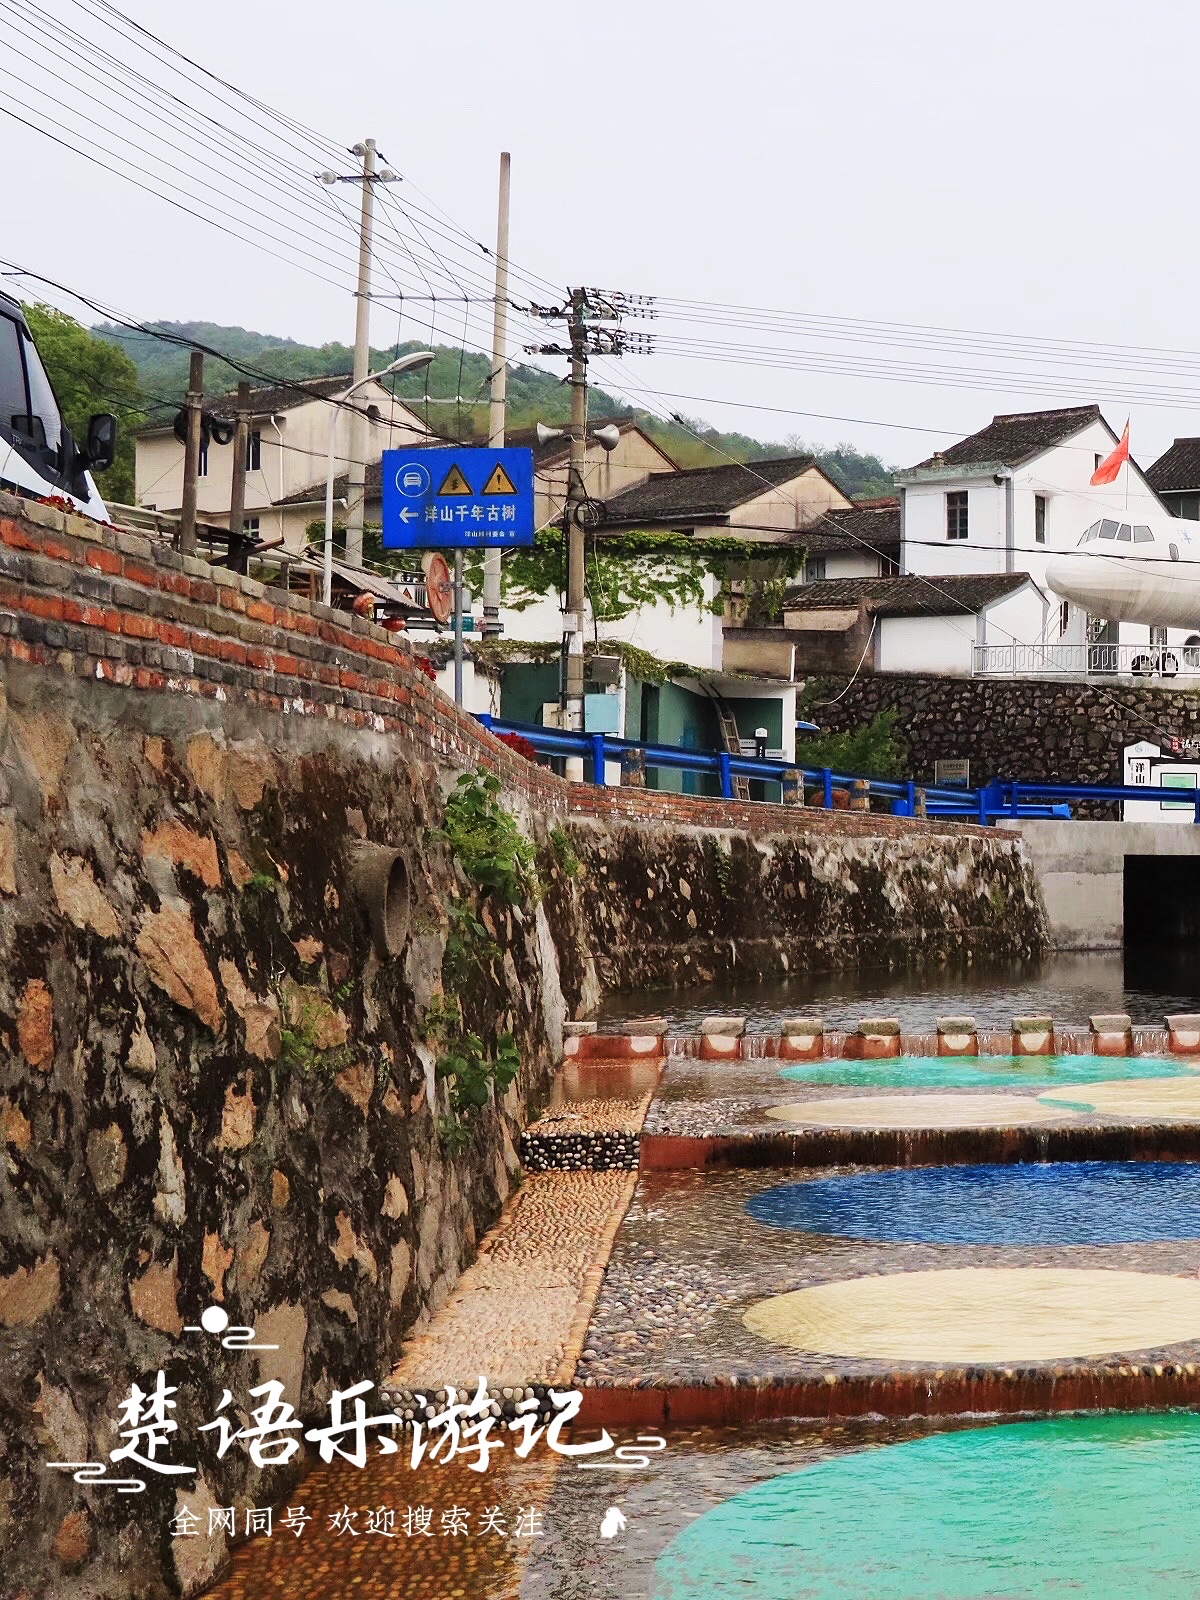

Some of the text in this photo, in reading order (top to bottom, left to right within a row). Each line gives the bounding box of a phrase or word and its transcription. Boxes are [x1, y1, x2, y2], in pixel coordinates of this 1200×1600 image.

[424, 504, 516, 522] 洋山千年古树
